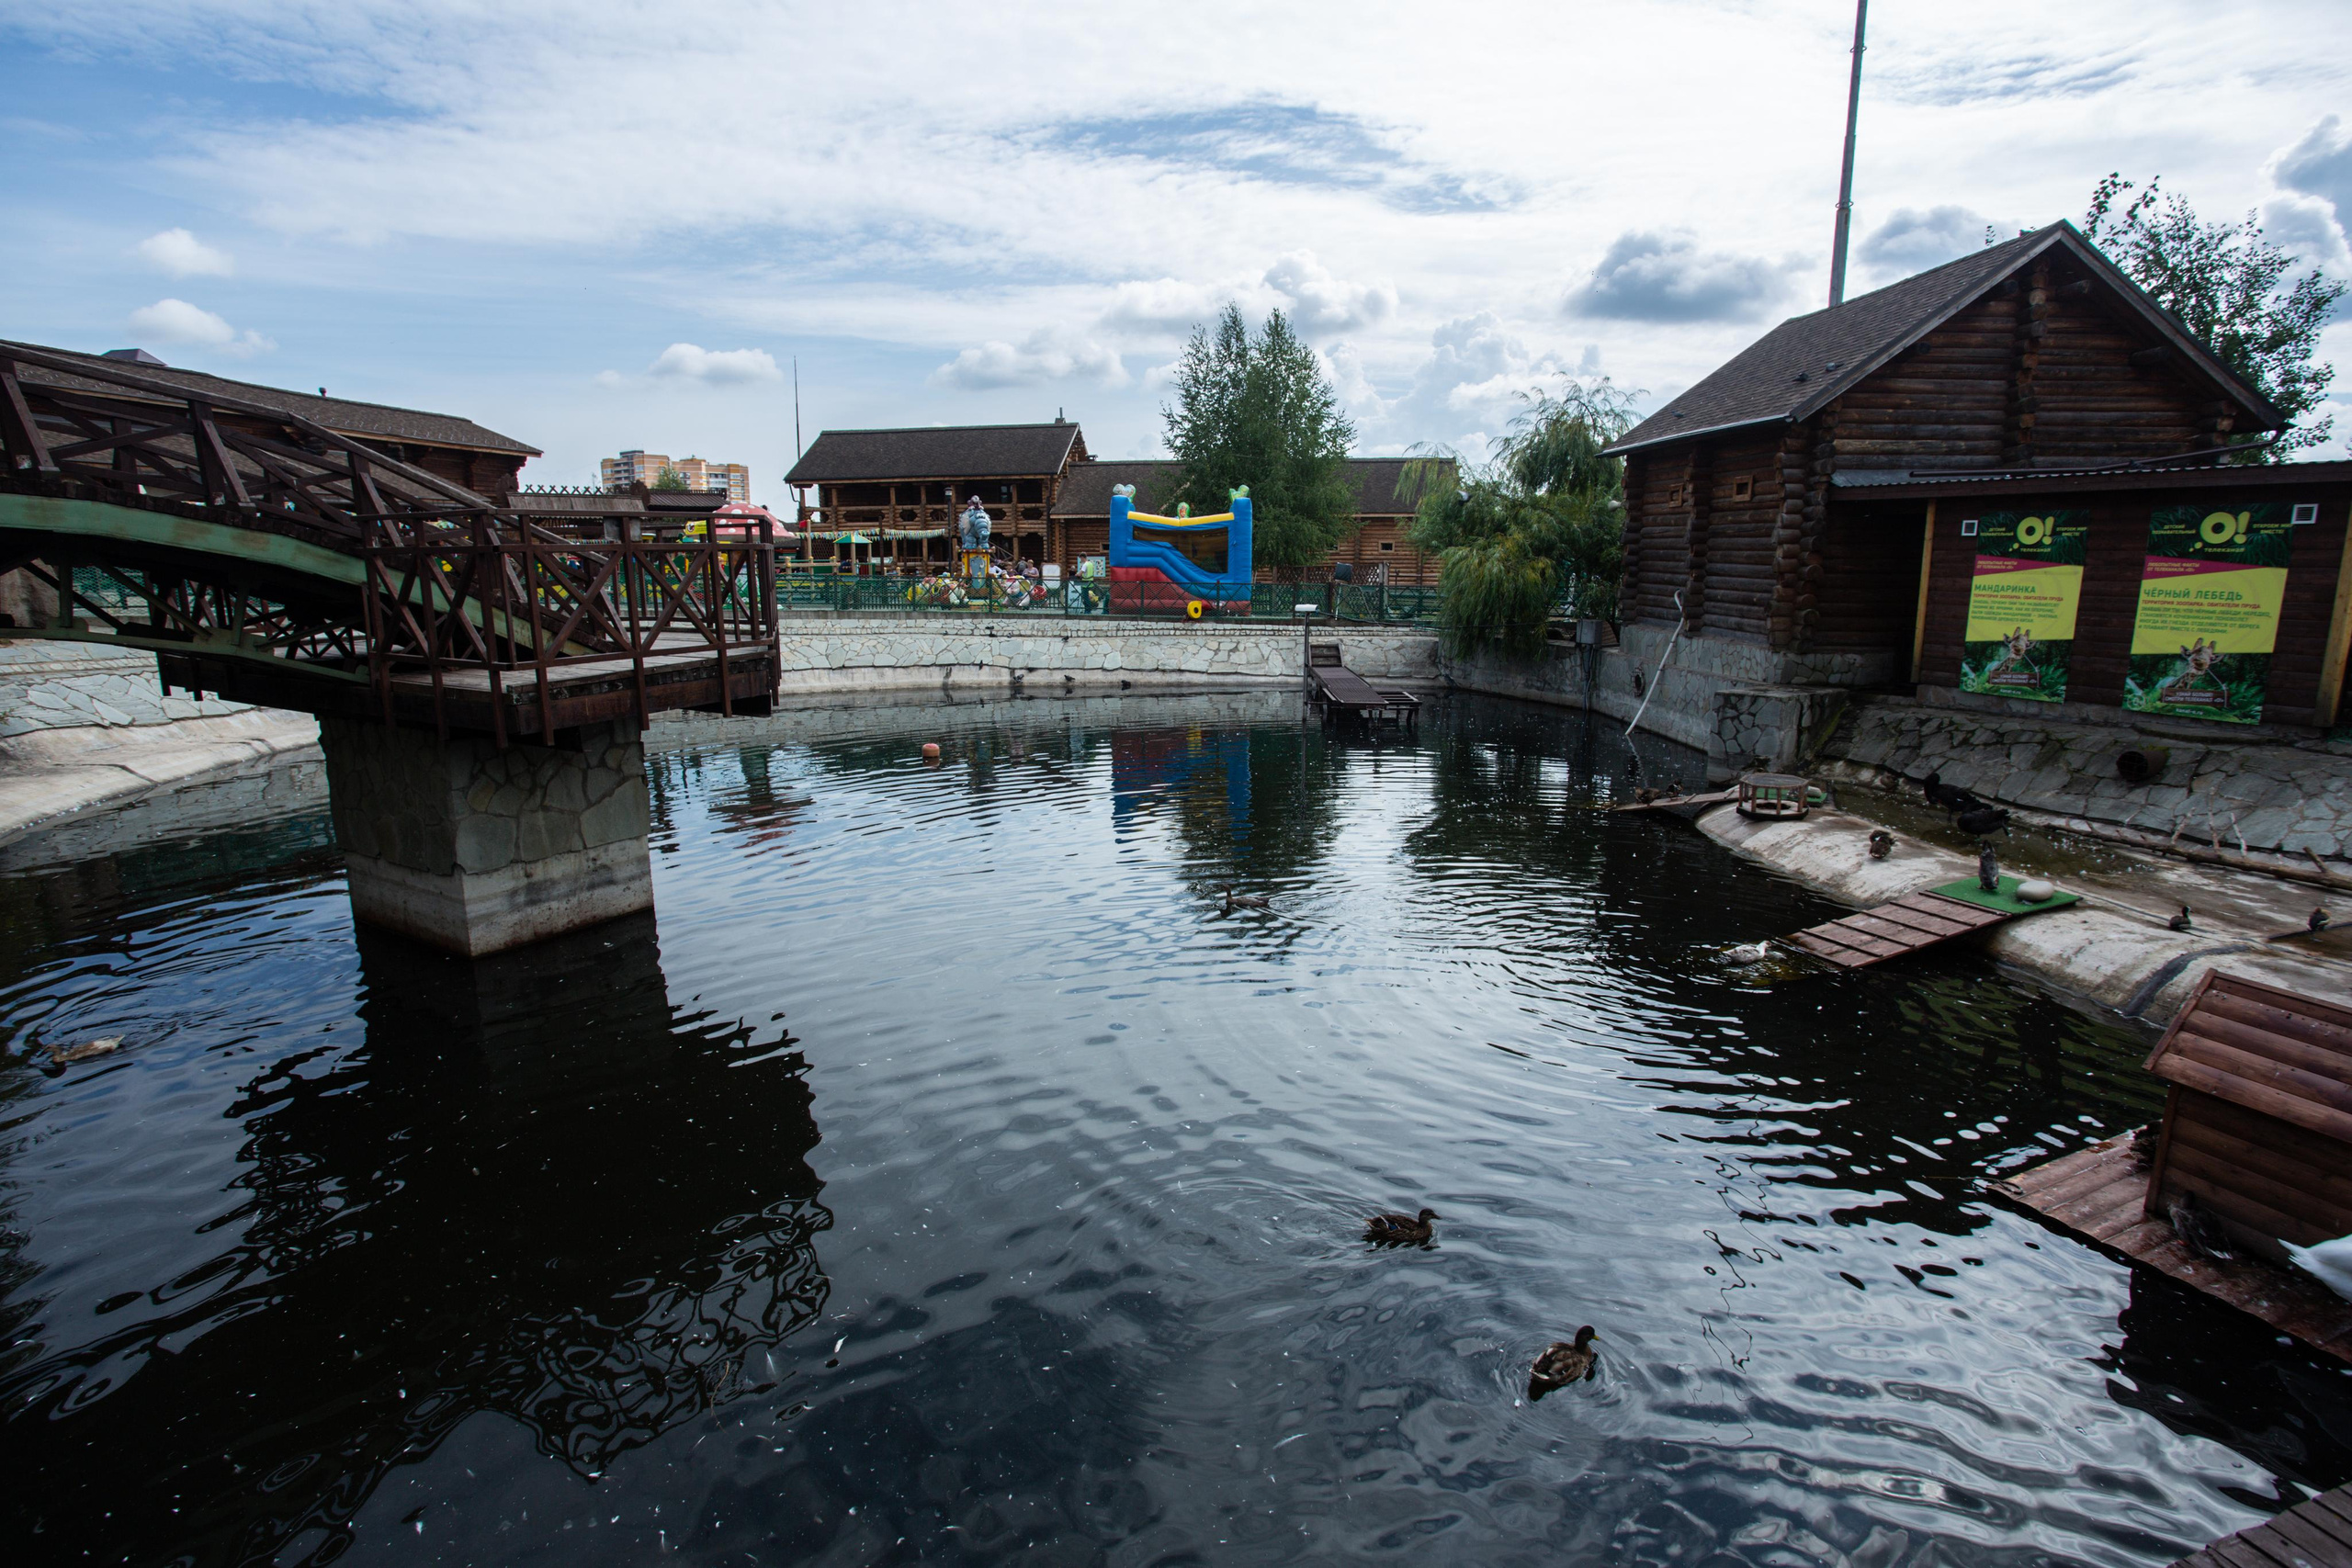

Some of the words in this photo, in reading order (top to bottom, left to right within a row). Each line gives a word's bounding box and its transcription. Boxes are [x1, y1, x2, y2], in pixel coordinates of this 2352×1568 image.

[1974, 584, 2036, 593] МАНДАРИНКА
[2143, 588, 2190, 600] ЧЁРНЫЙ
[2194, 591, 2244, 602] ЛЕБЕДЬ
